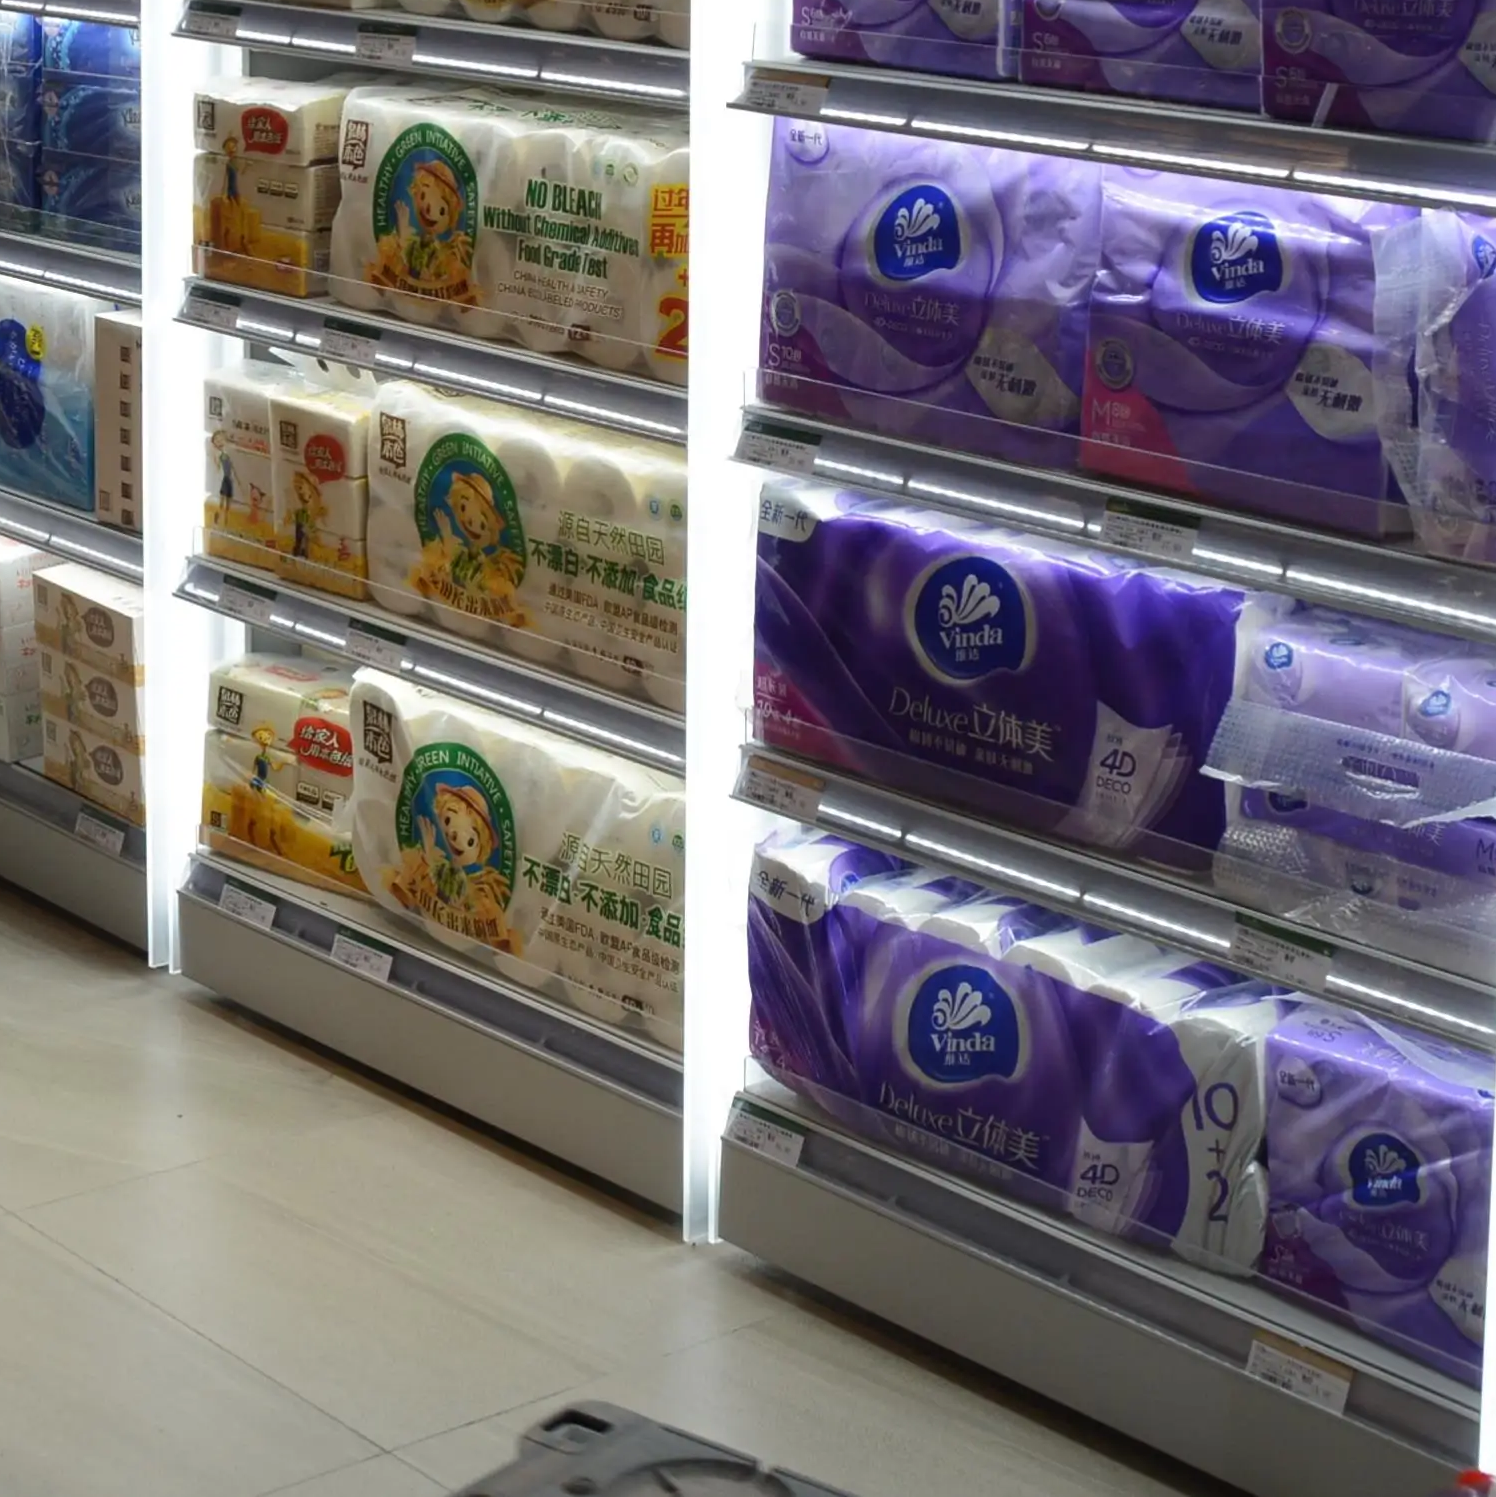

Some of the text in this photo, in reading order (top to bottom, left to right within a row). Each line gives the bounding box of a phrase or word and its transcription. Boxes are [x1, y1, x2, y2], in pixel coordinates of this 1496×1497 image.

[376, 165, 394, 227] HEALTHY
[394, 131, 422, 159] GREEN
[526, 179, 603, 221] NO BLEACH
[484, 206, 639, 257] Without Chemical Additives
[893, 236, 944, 260] Vinda
[517, 240, 608, 279] Food Grade Test
[1211, 258, 1265, 281] Vinda
[910, 295, 961, 326] 立体美
[1227, 317, 1286, 345] 立体美
[432, 442, 459, 468] GREEN
[760, 500, 807, 532] 全新一代
[558, 510, 665, 566] 源自天然田园
[939, 624, 1003, 650] Vinda
[888, 687, 1054, 762] Deluxe 立体美
[1100, 749, 1137, 777] 4D
[1096, 775, 1132, 795] DECO
[502, 819, 512, 877] SAFETY
[561, 831, 672, 899] 源自天然田园
[758, 870, 815, 918] 全新一代
[931, 1033, 995, 1052] Vinda
[1193, 1082, 1238, 1130] 10
[879, 1082, 1039, 1170] Deluxe 立体美
[1080, 1164, 1119, 1185] 4D
[1209, 1173, 1228, 1222] 2
